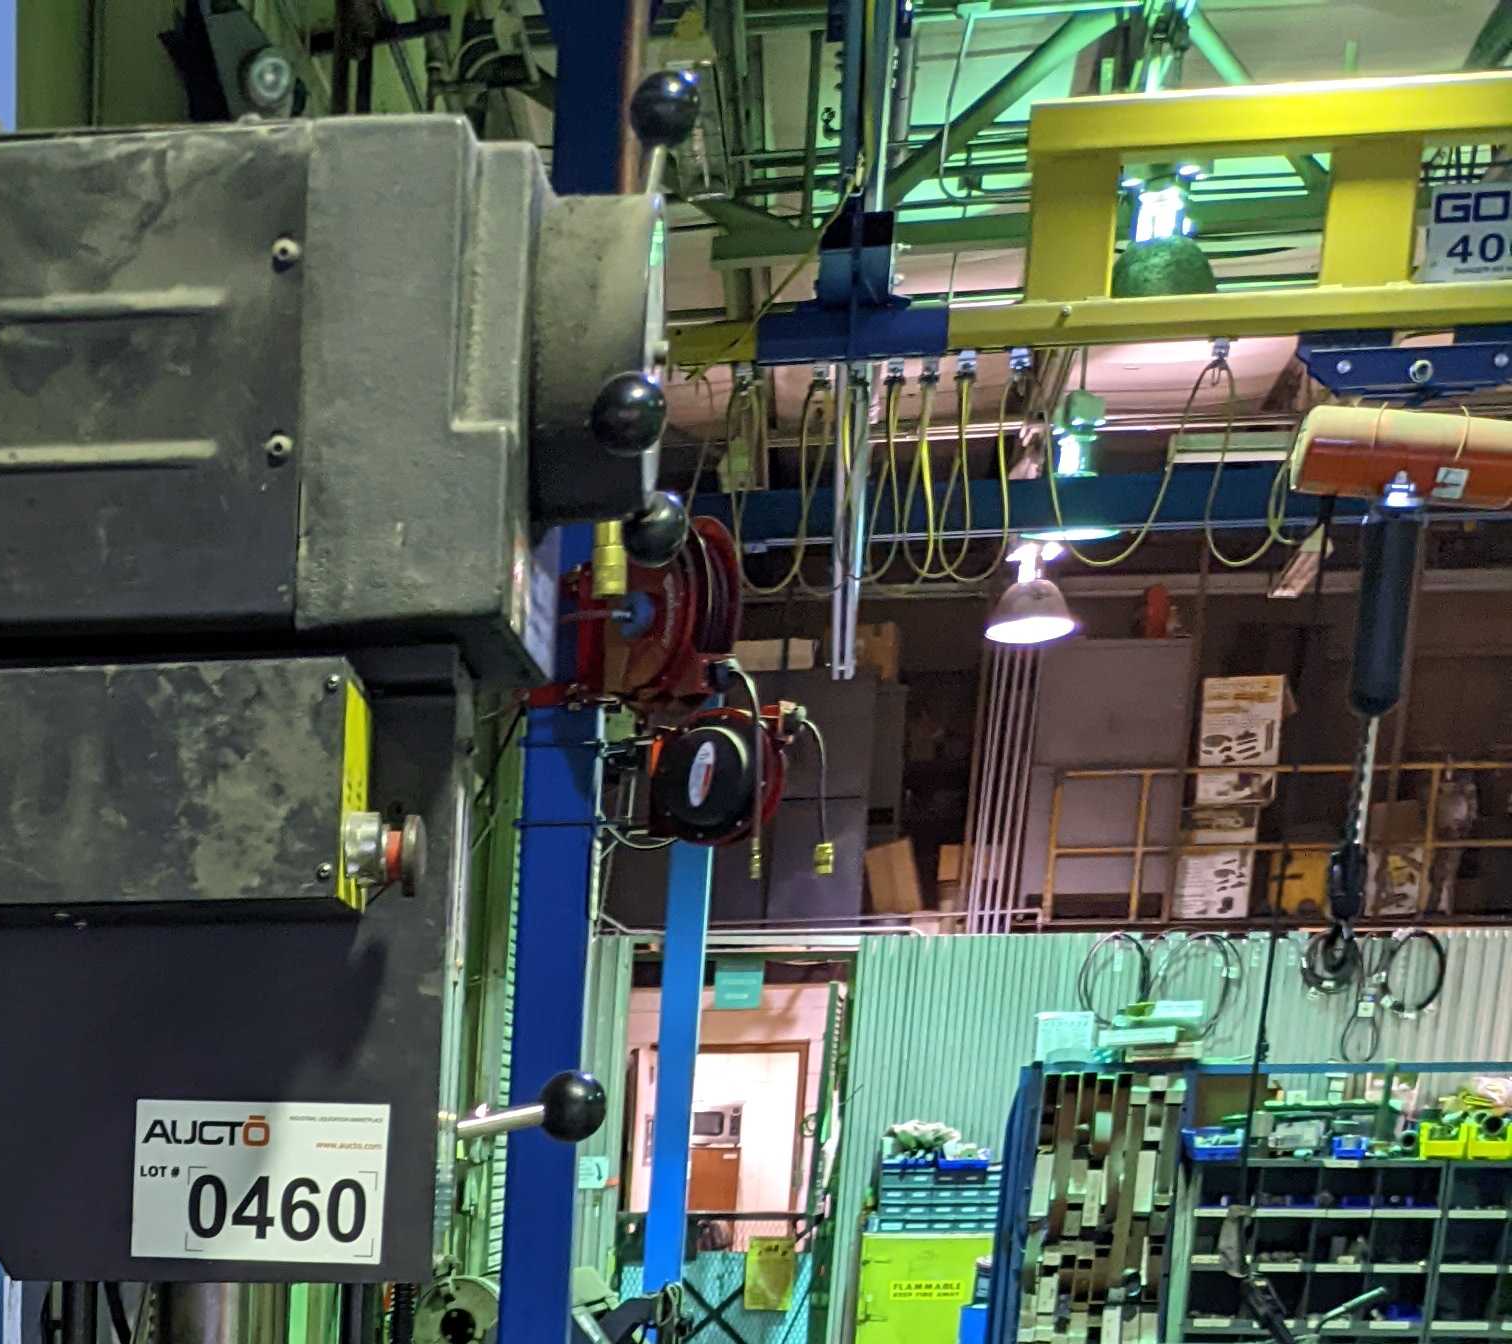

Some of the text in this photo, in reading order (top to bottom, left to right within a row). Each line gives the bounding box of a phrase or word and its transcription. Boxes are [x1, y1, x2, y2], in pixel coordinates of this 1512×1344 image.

[1446, 232, 1512, 264] 40
[139, 1165, 181, 1178] LOT #
[188, 1174, 367, 1243] 0460
[892, 1282, 961, 1290] FLAMMABLE
